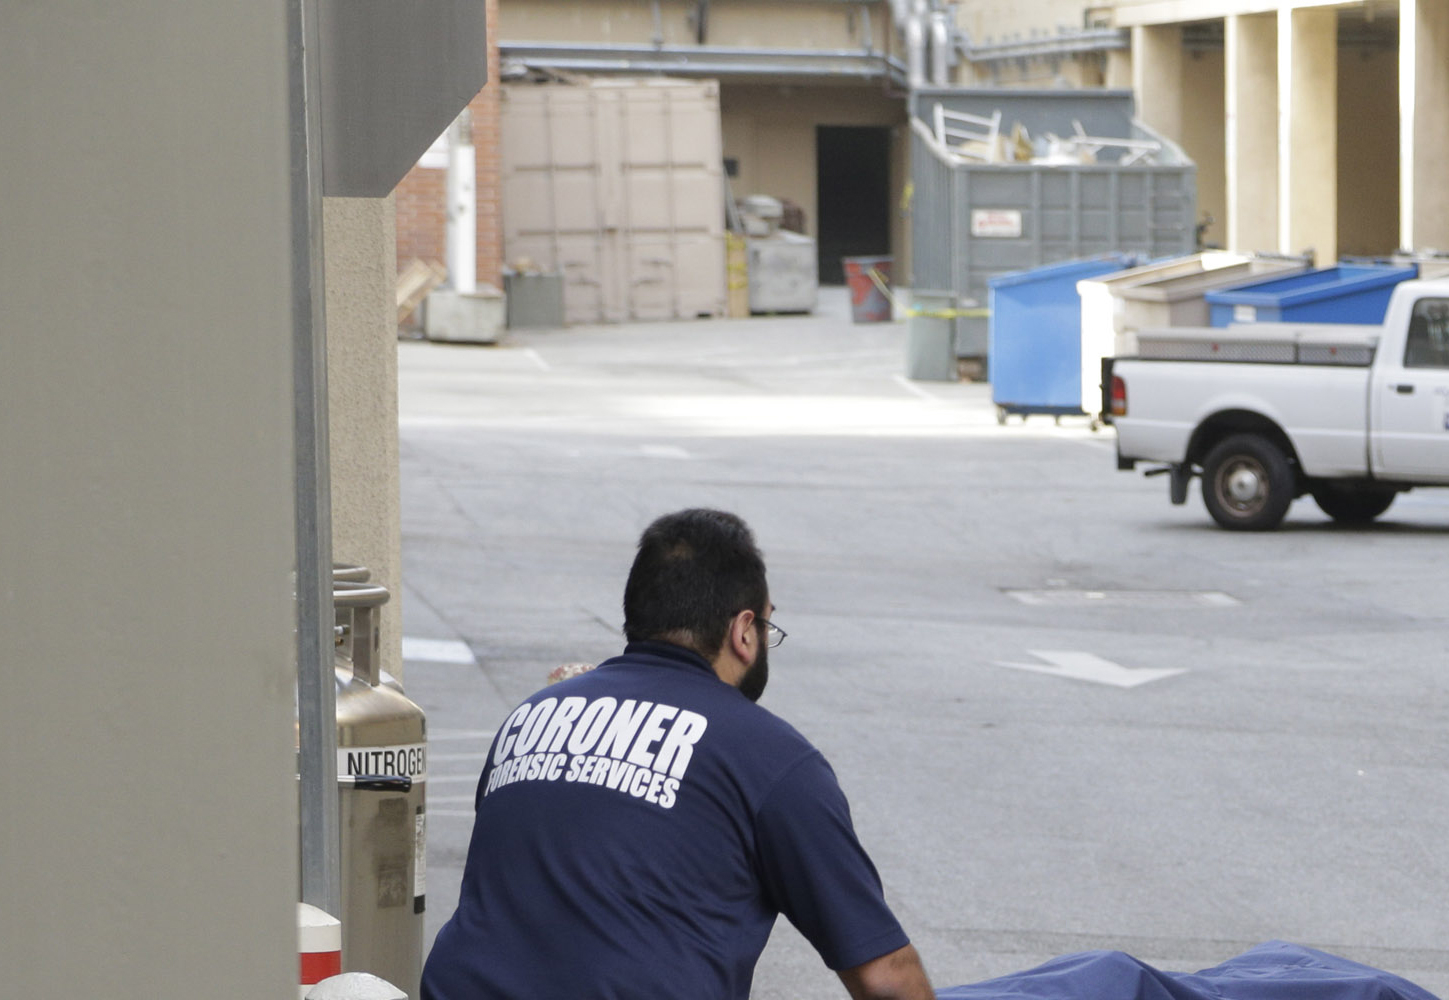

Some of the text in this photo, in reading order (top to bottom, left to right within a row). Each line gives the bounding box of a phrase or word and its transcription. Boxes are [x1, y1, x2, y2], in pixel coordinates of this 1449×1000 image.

[493, 696, 708, 780] CORONER
[484, 753, 681, 809] FORENSIC SERVICES
